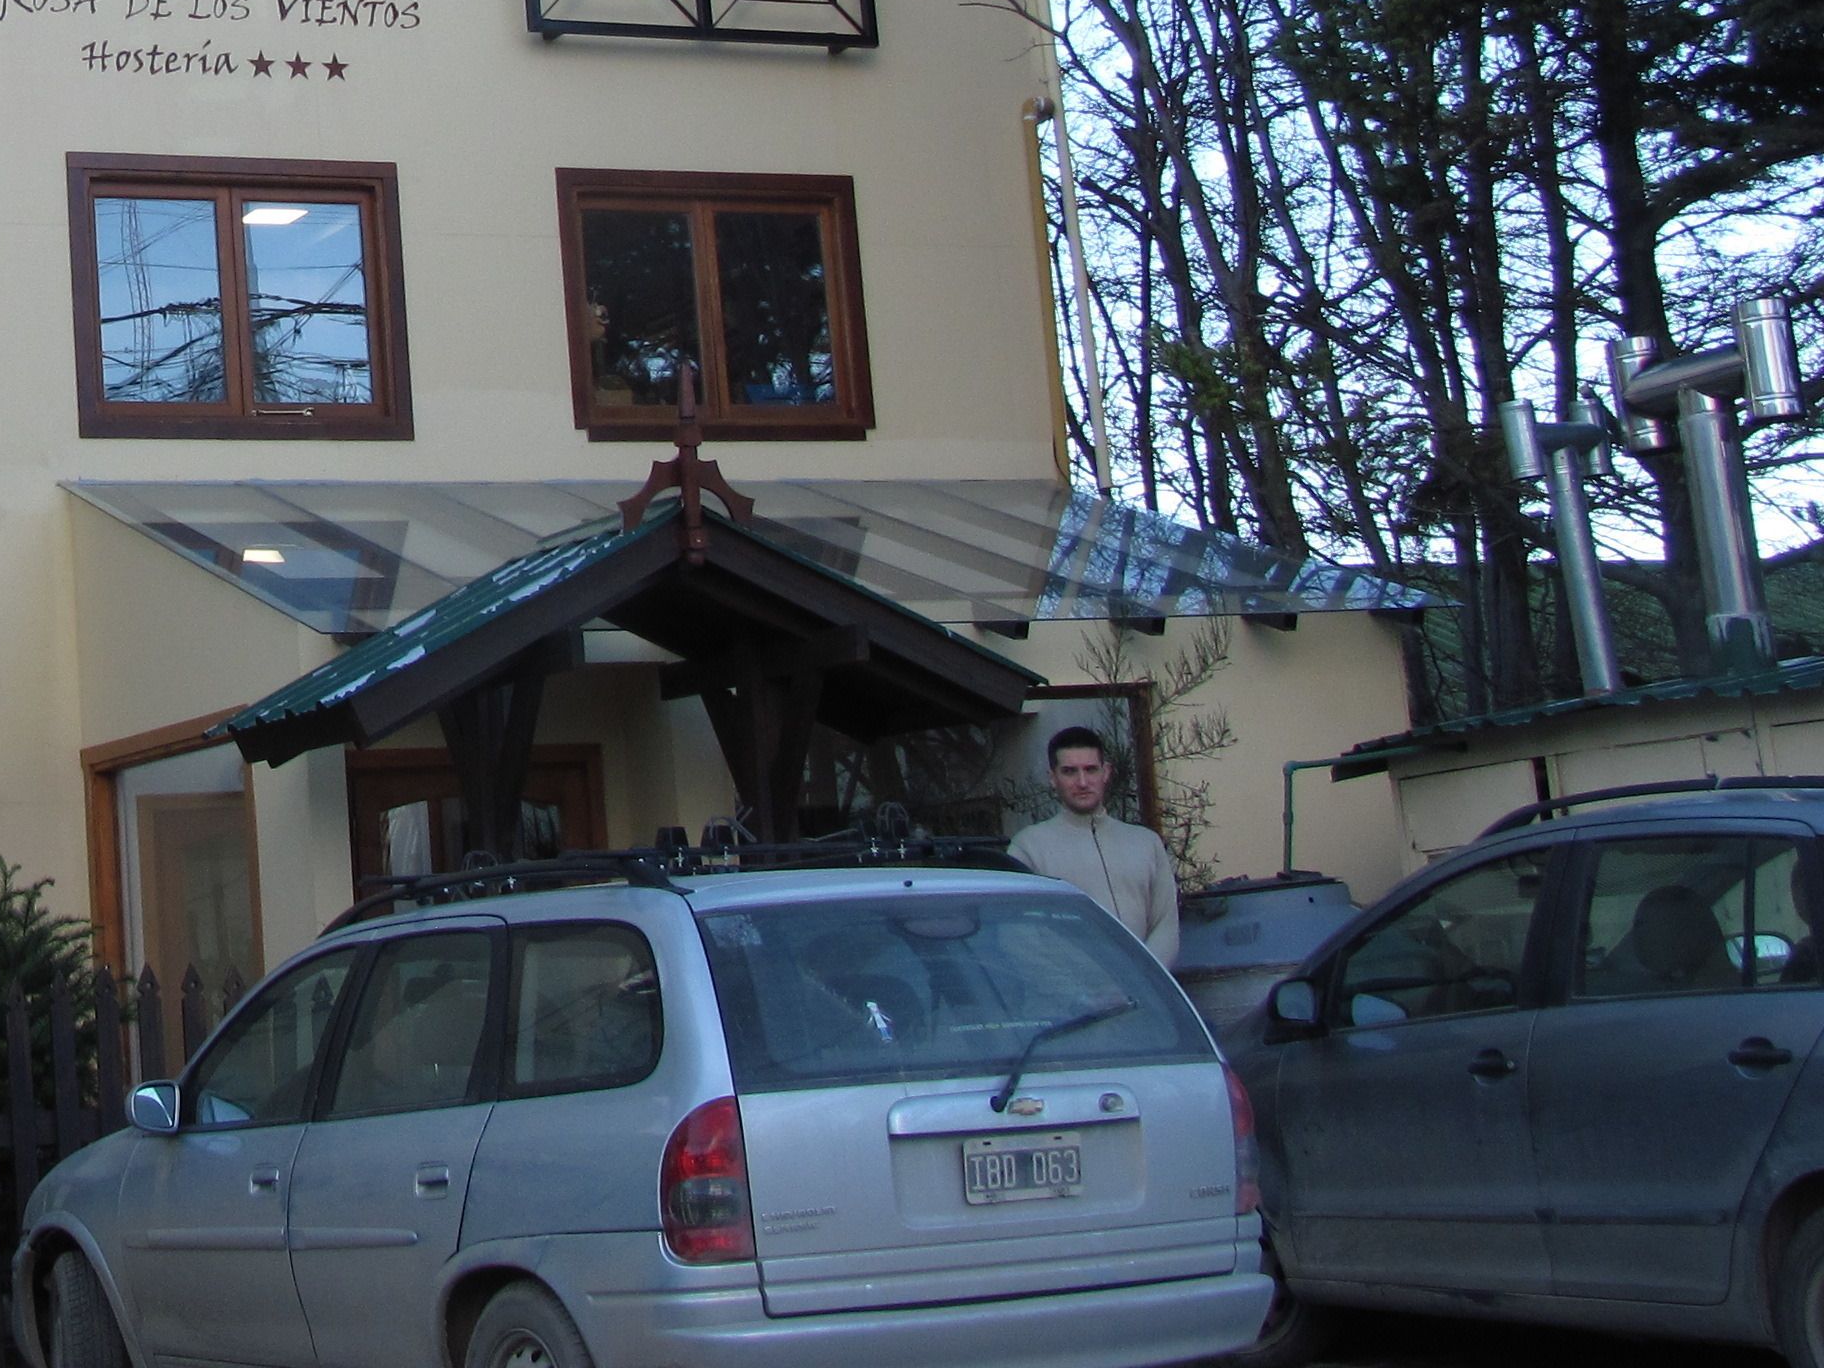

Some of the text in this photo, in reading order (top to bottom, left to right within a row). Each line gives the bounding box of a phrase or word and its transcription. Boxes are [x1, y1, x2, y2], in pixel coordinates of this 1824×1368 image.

[81, 39, 238, 76] Hostería
[971, 1150, 1079, 1190] IBD 063
